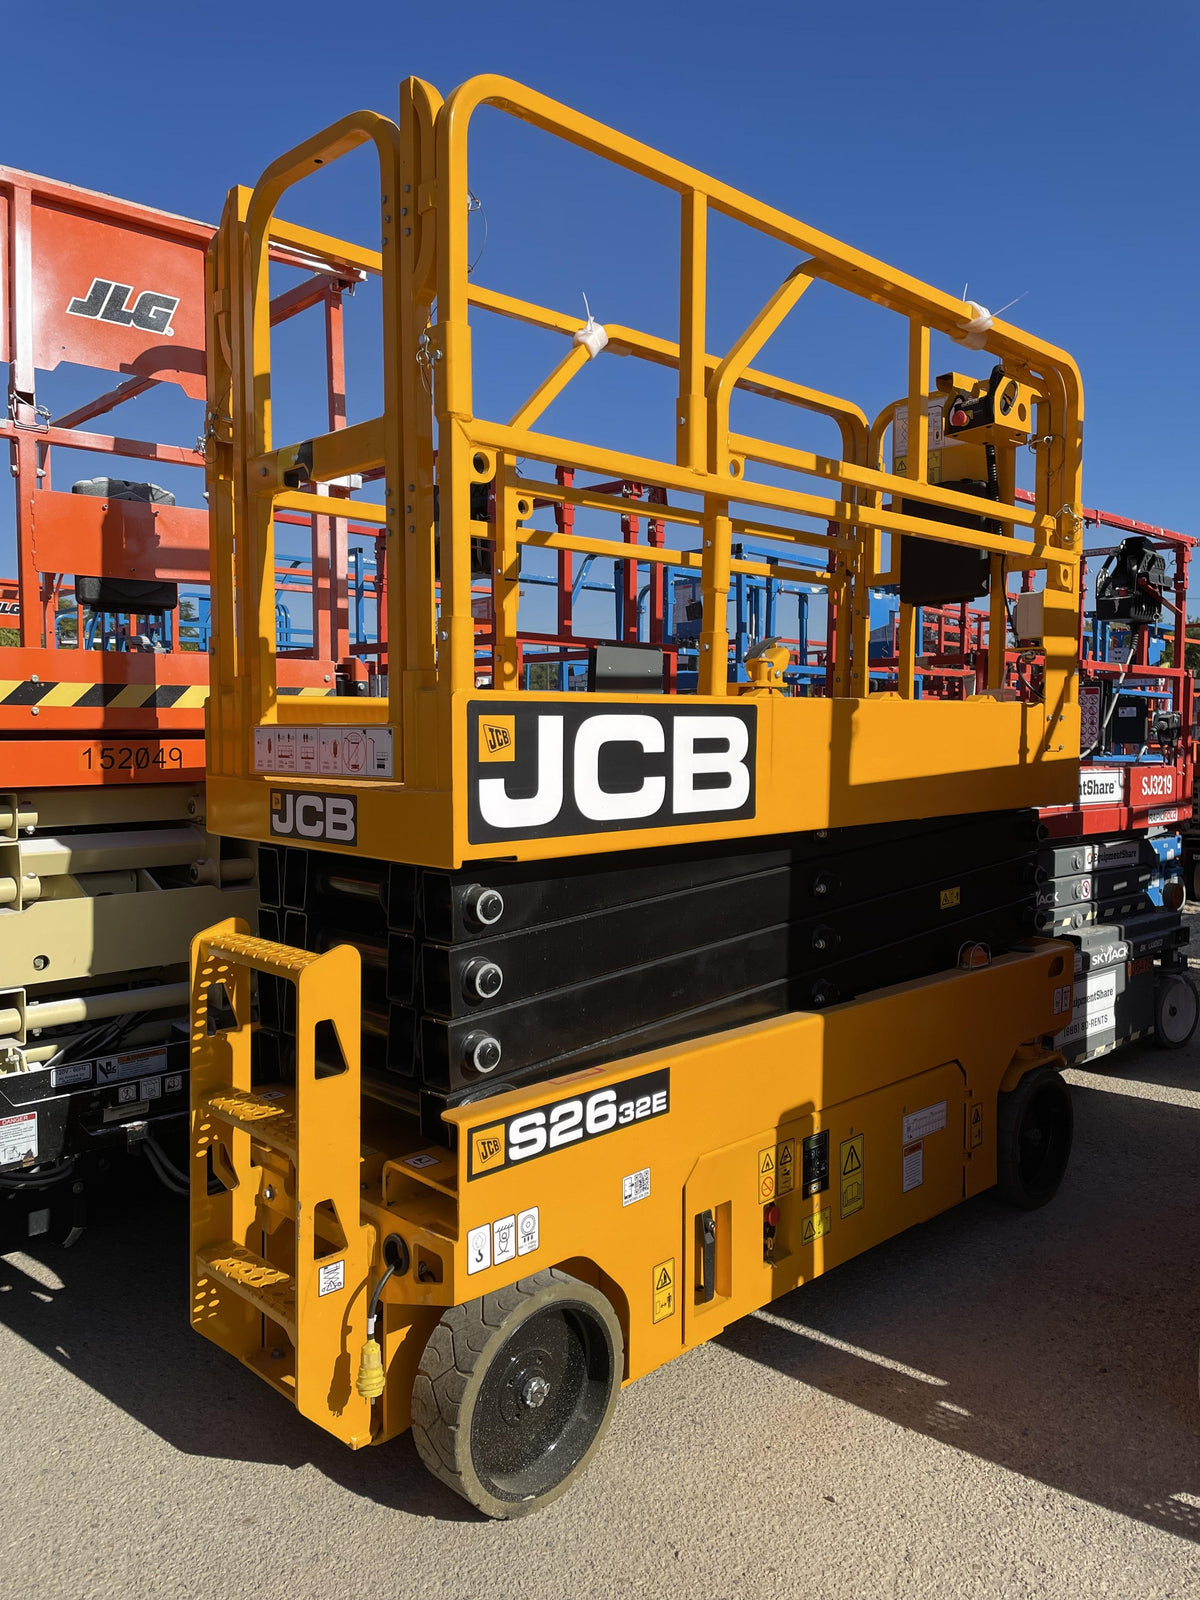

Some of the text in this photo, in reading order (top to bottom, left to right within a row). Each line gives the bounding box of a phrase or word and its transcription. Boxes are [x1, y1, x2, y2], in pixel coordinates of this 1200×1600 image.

[66, 277, 180, 335] JLG
[0, 601, 20, 615] LG
[488, 726, 510, 750] JCB
[82, 747, 183, 770] 152049
[478, 714, 750, 828] JCB
[1141, 775, 1173, 796] SJ3219
[272, 793, 355, 841] JCB
[1091, 944, 1129, 966] SKYJACK
[2, 1115, 29, 1126] DANGER
[508, 1089, 667, 1161] S26 32E
[481, 1138, 500, 1160] JCB
